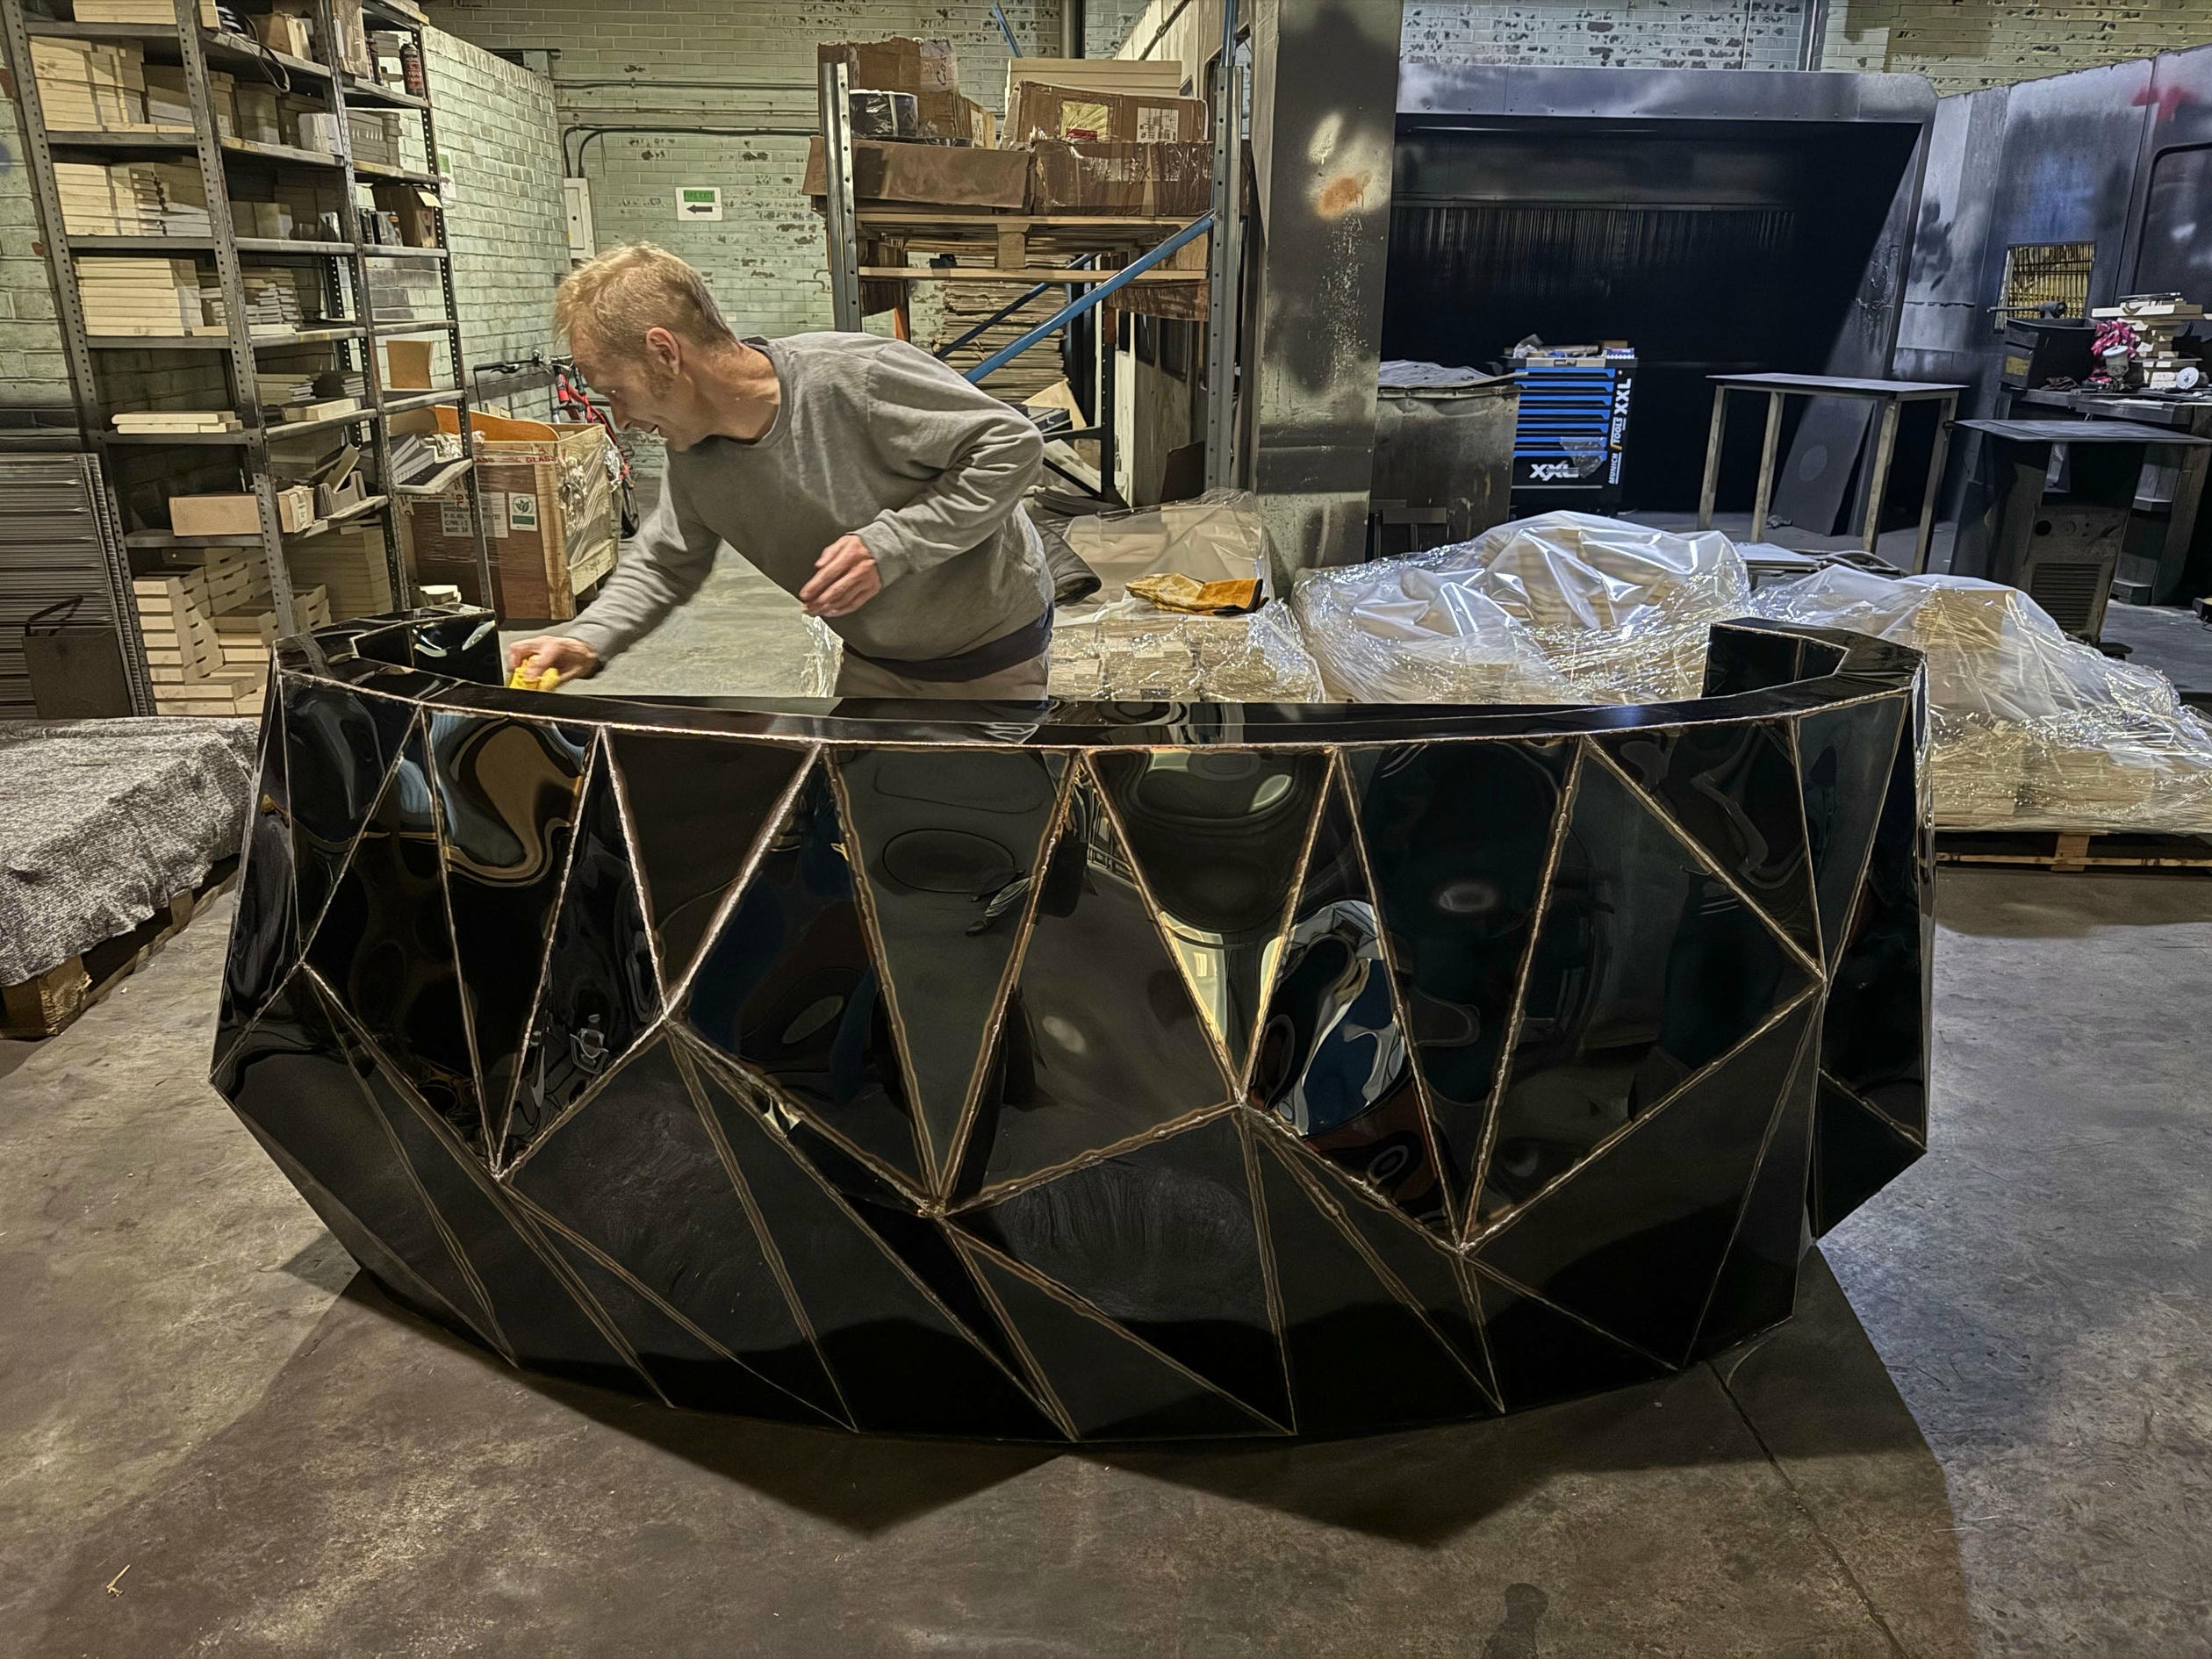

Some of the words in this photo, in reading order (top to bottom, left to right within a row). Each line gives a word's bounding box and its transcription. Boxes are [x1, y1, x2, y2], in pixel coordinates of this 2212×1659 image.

[1613, 378, 1632, 415] XXL
[1612, 417, 1623, 444] TOOLS
[1529, 460, 1579, 481] XXL
[1608, 452, 1619, 485] MUNICH
